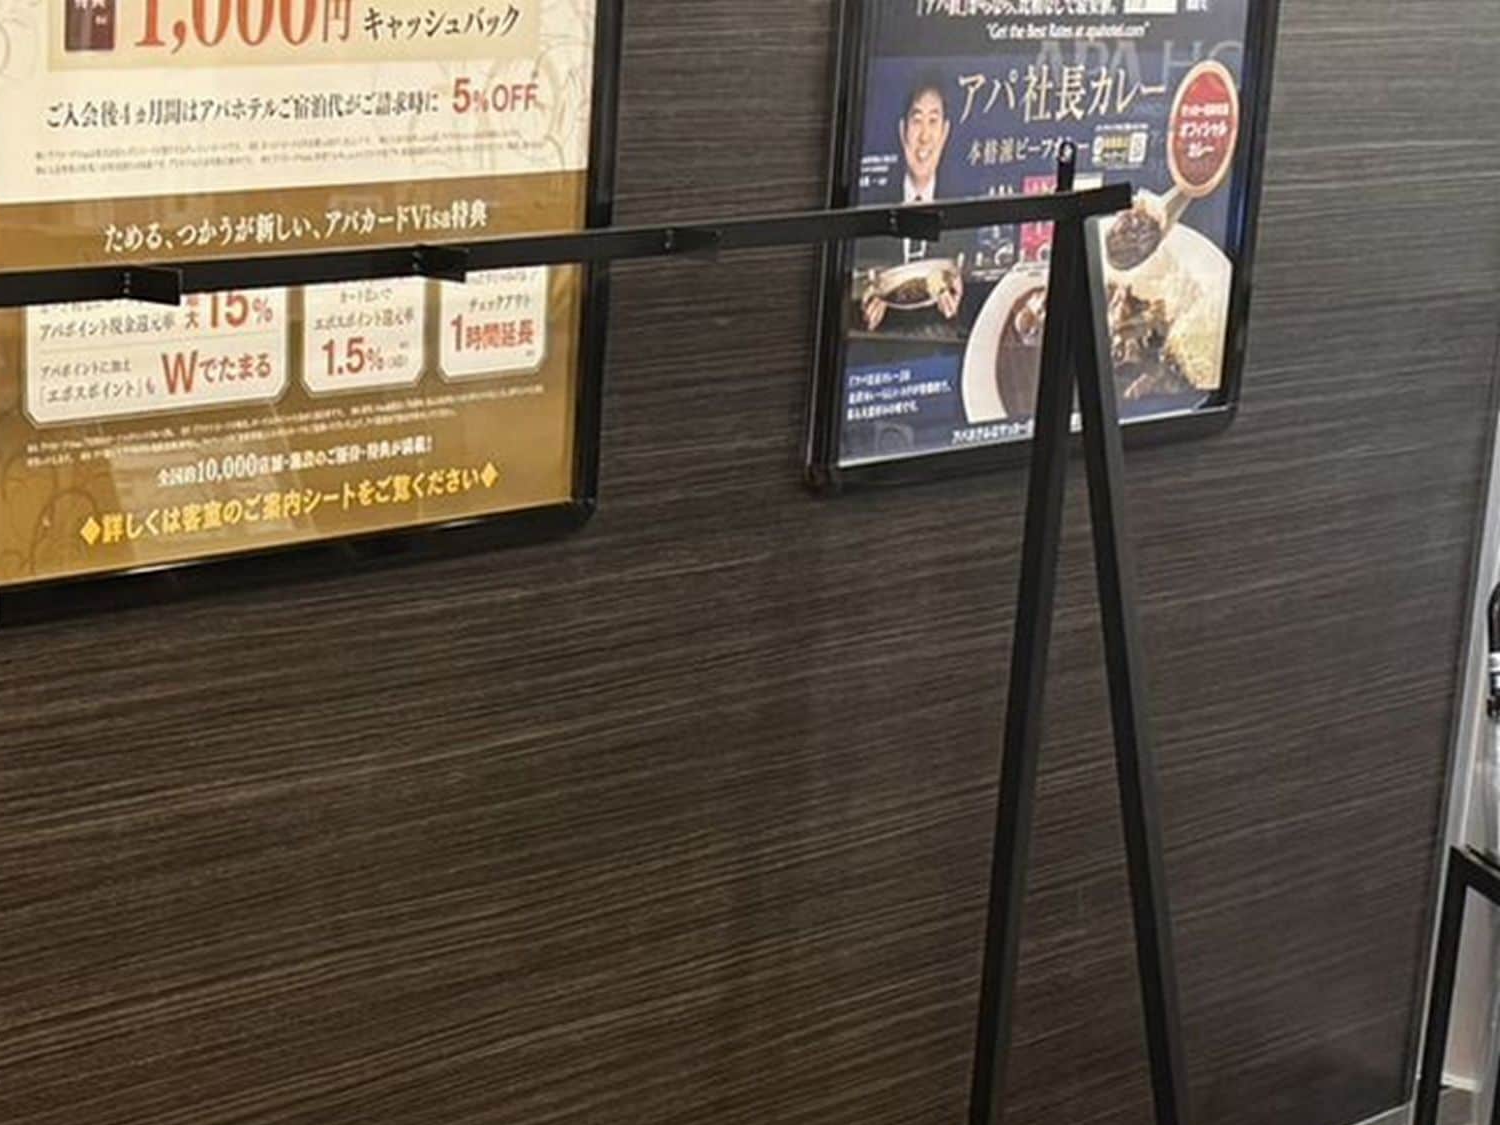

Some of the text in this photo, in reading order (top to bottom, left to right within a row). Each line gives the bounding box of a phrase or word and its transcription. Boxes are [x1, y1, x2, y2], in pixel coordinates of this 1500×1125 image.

[363, 4, 521, 43] キャッシュバック
[958, 62, 1167, 124] アパ社長カレー
[105, 199, 487, 253] ためる、つかうが新しい、アパカードVisa特典
[450, 313, 534, 353] 1時間延長
[161, 349, 272, 395] Wでたまる
[321, 336, 384, 376] 1.5%
